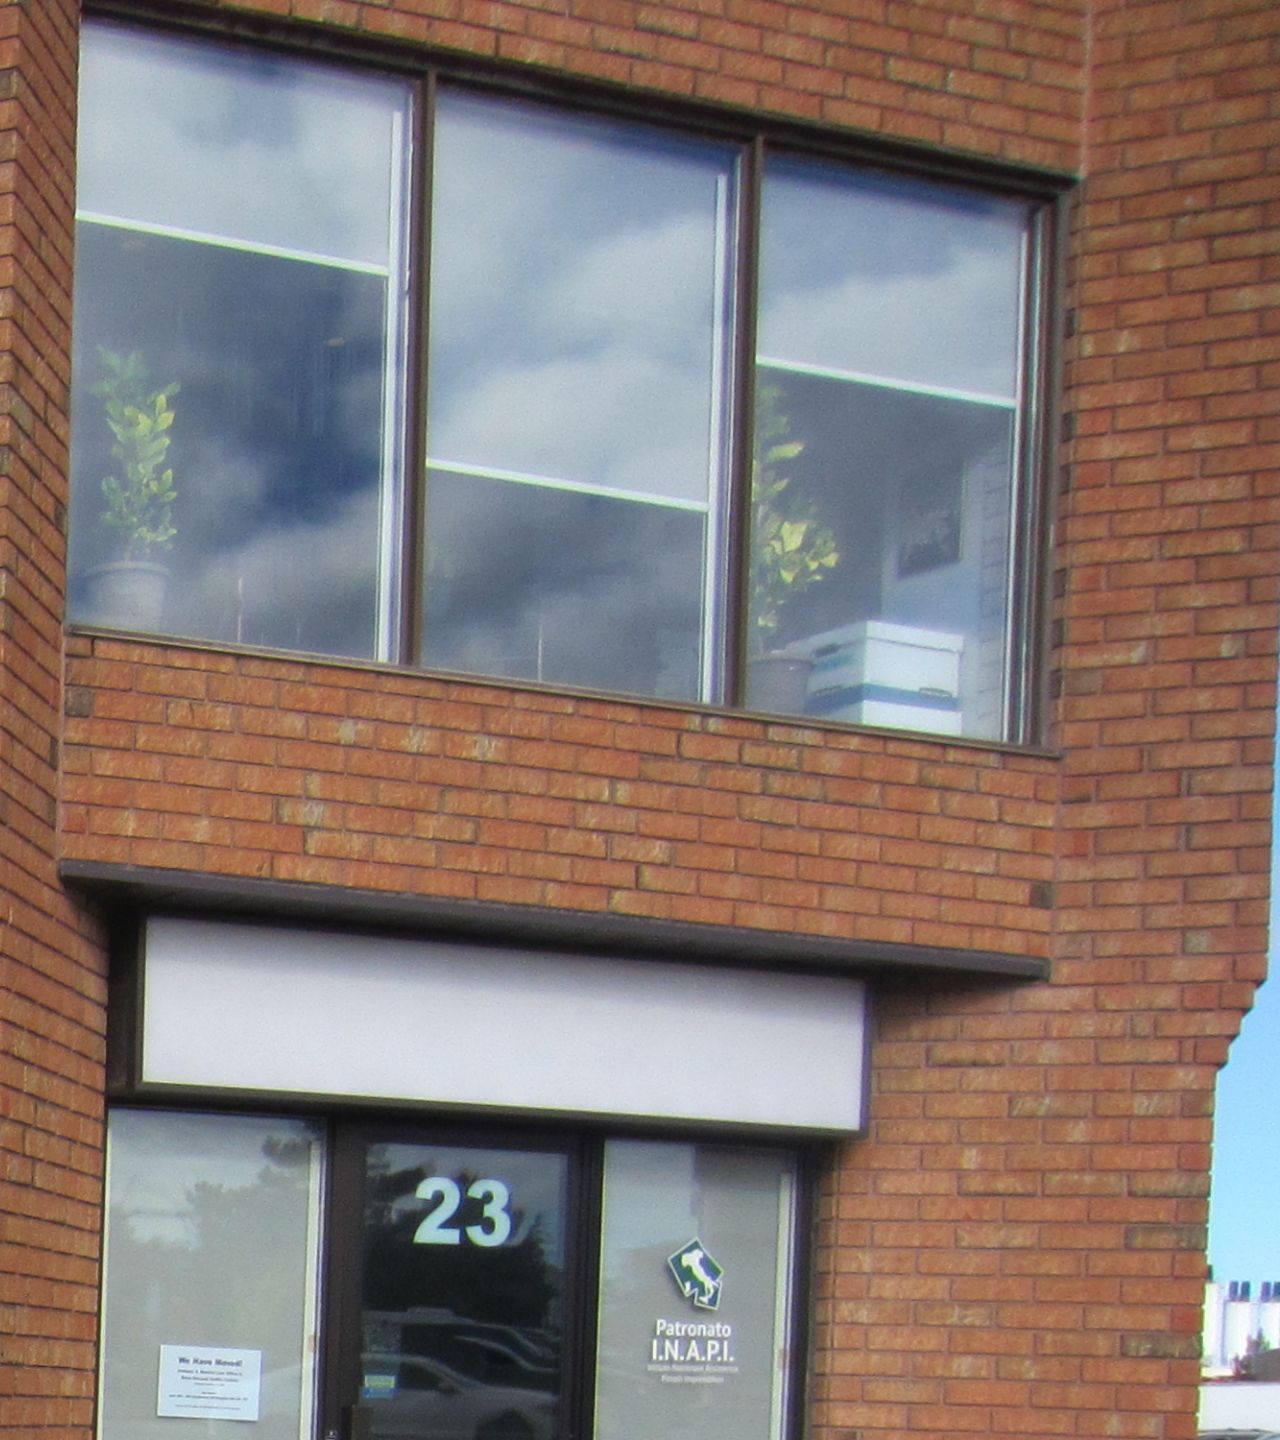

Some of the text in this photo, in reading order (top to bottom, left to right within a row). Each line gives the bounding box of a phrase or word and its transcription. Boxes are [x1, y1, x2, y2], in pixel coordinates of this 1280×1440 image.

[413, 1176, 511, 1248] 23
[656, 1319, 732, 1337] Patronato
[652, 1339, 734, 1362] I.N.A.P.I.
